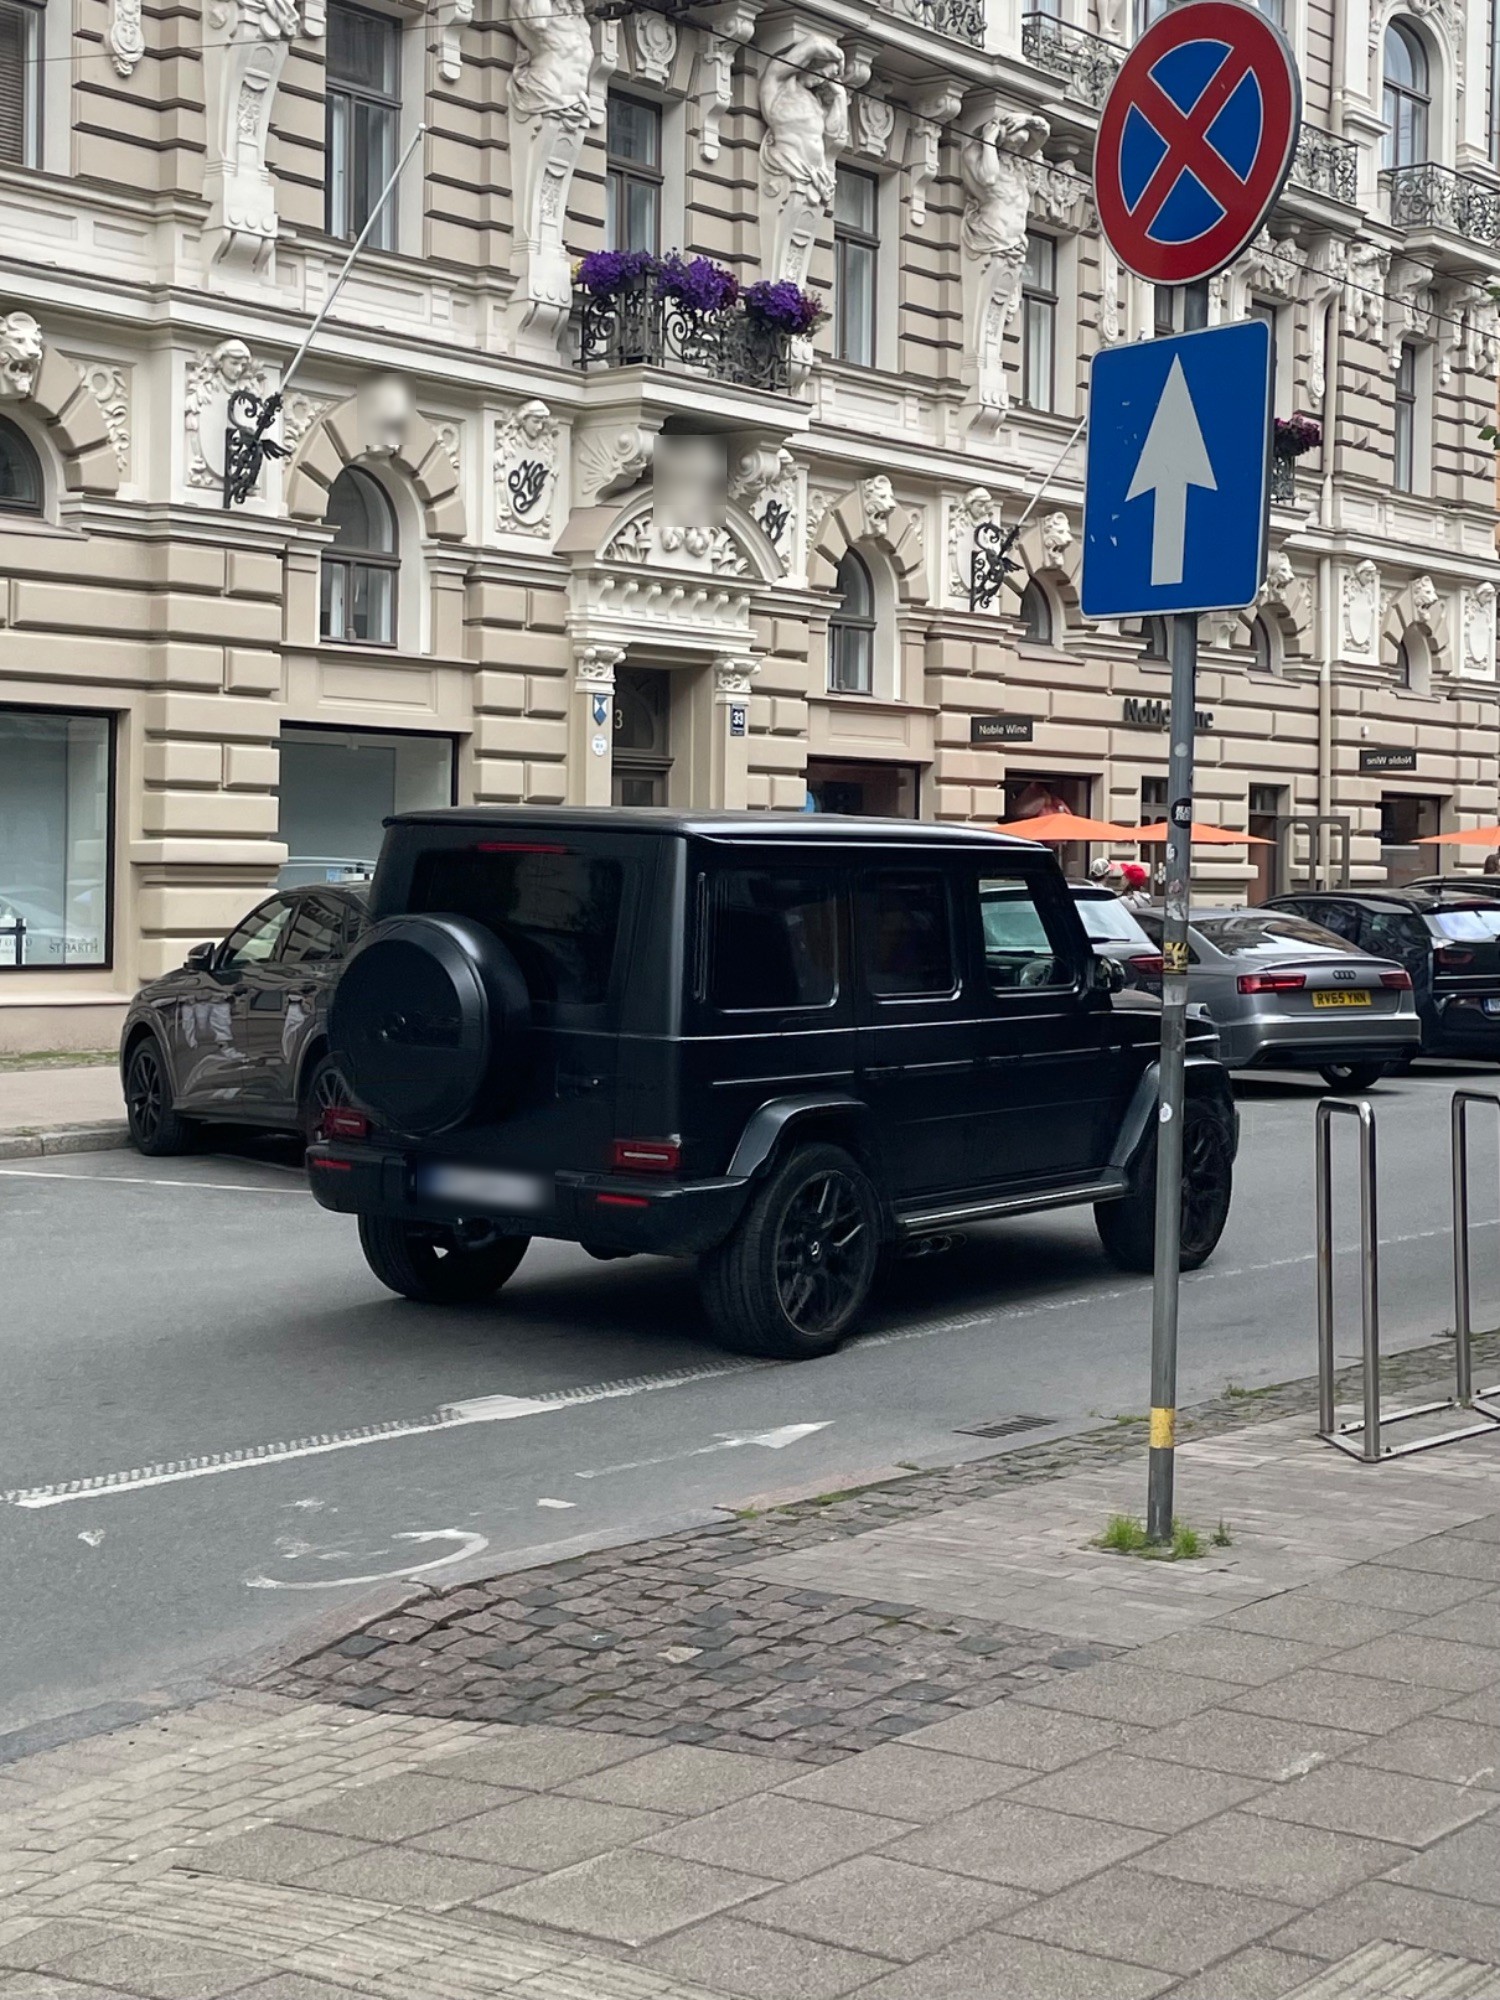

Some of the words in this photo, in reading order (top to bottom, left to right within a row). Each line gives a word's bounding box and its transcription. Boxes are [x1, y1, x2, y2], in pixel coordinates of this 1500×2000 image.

[733, 711, 744, 725] 33
[979, 724, 1004, 735] Noble
[1005, 724, 1027, 734] Wine
[1315, 992, 1345, 1005] RV65
